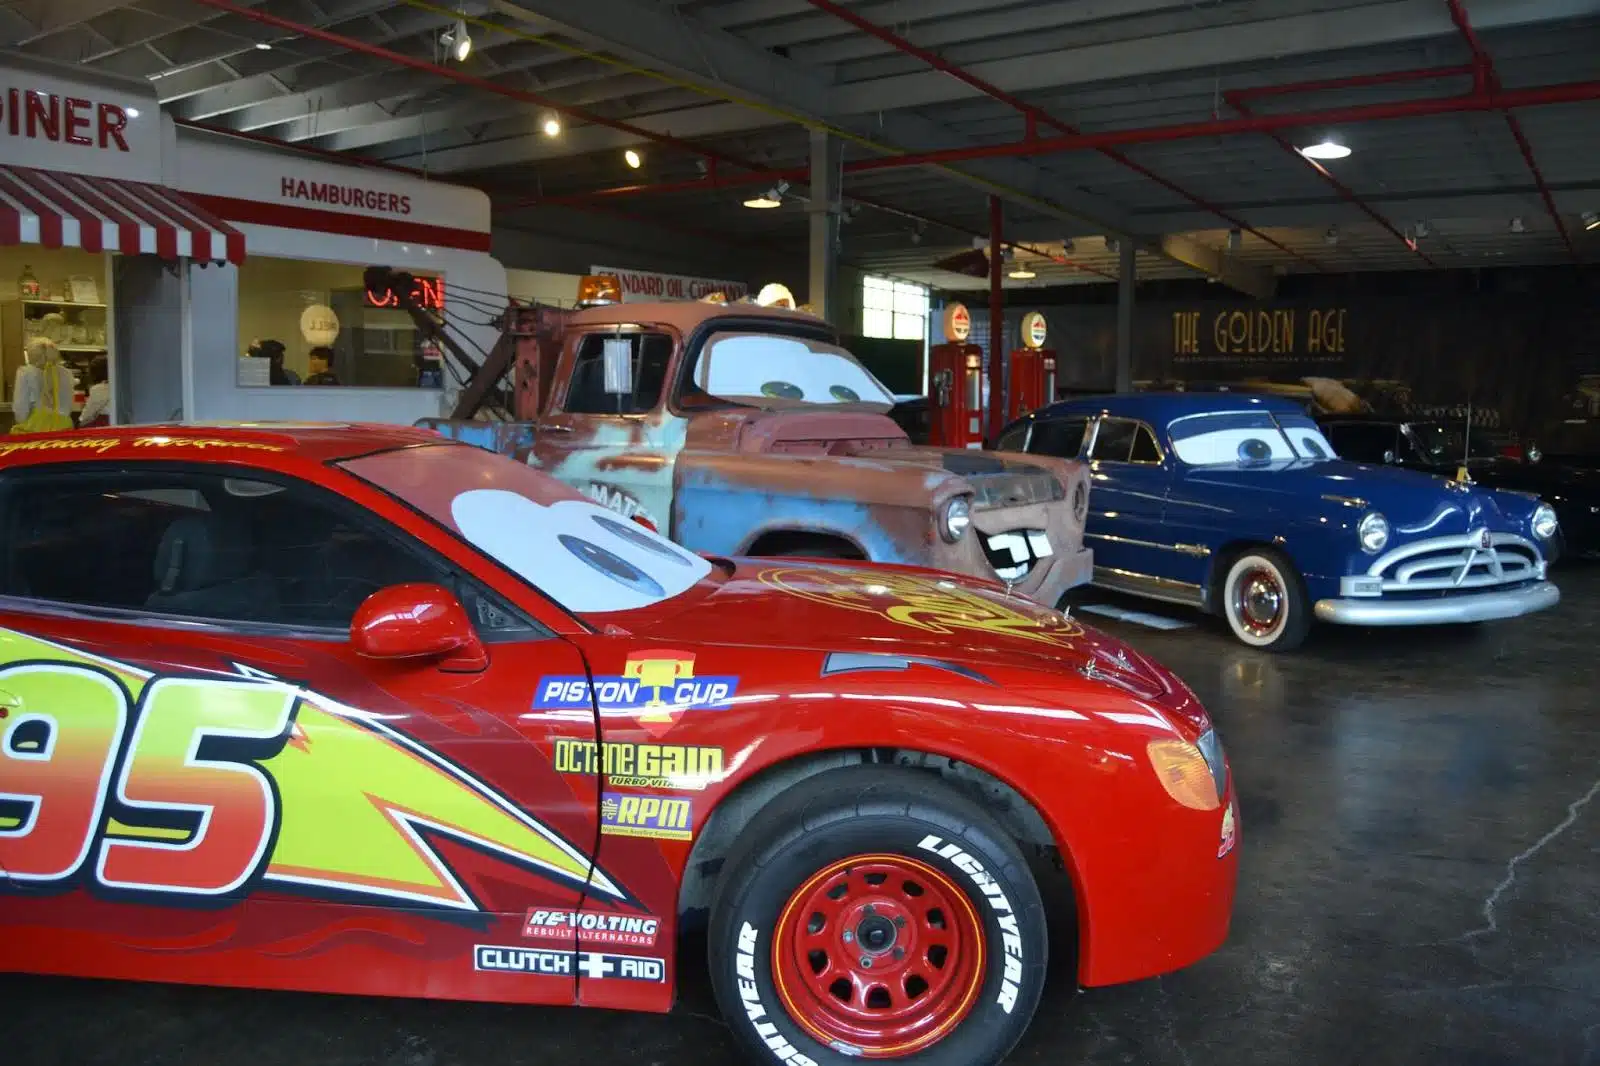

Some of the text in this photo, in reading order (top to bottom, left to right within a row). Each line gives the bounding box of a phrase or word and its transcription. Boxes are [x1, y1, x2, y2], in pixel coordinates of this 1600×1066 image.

[0, 88, 130, 152] INER
[281, 176, 411, 215] HAMBURGERS
[599, 271, 664, 297] NDARD
[667, 279, 683, 297] OIL
[1172, 308, 1347, 353] THE GOLDEN AGE
[543, 681, 729, 704] PISTON CUP
[0, 662, 301, 897] 95
[610, 777, 647, 786] TURBO
[617, 796, 690, 828] RPM
[526, 927, 573, 938] REBUILT
[917, 834, 1023, 1014] LIGHTYEAR
[482, 949, 661, 979] CLUTCH AID
